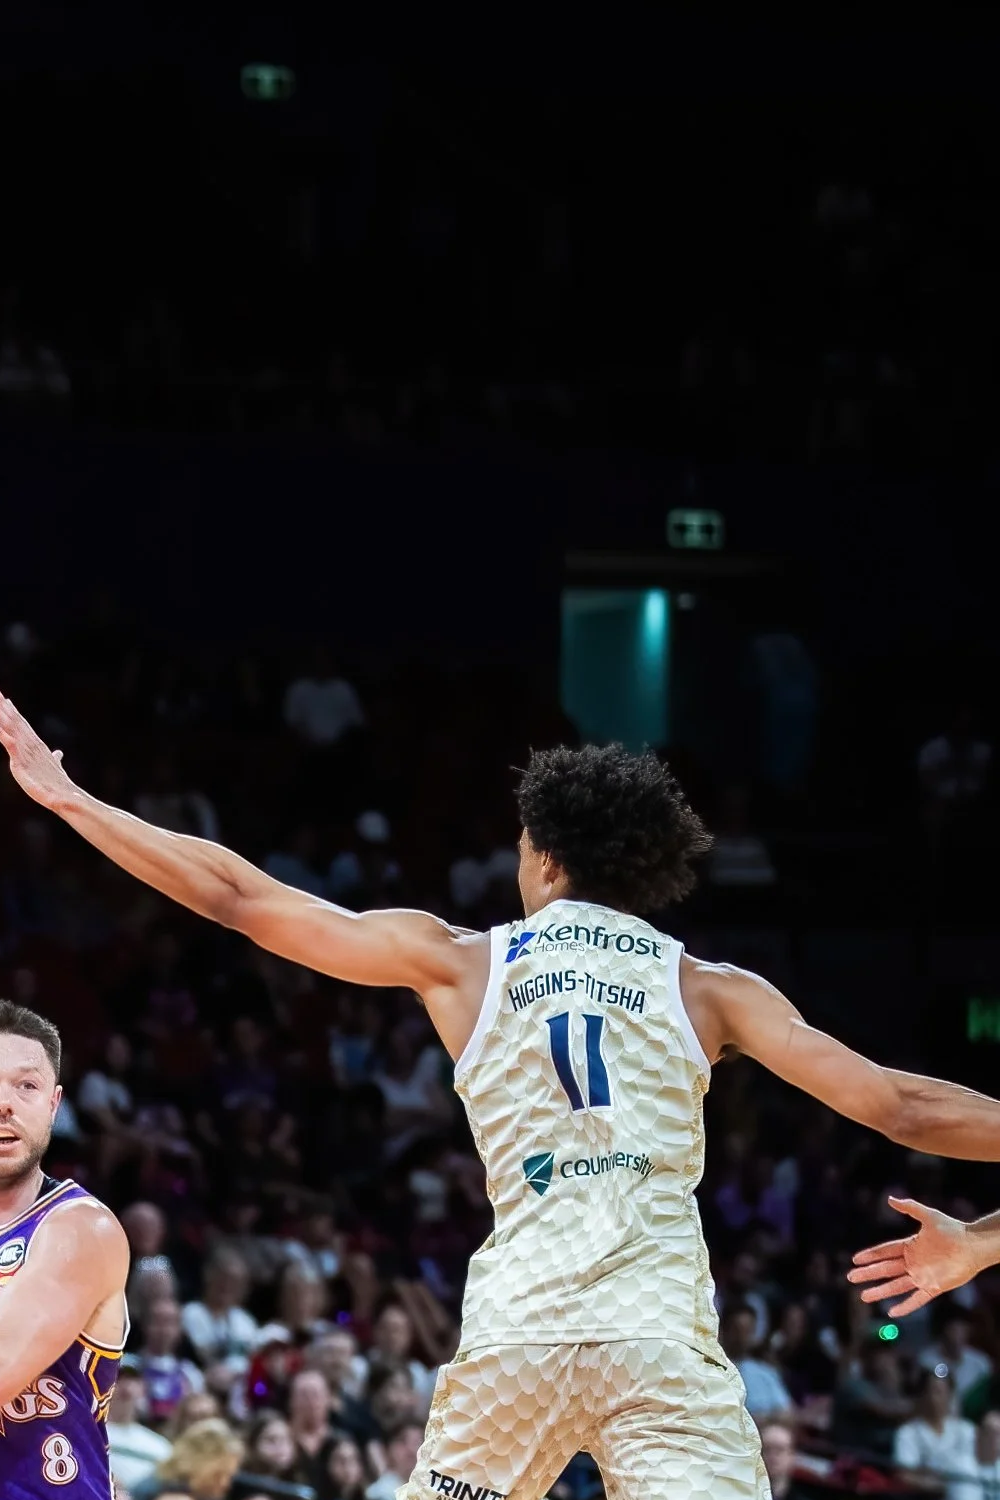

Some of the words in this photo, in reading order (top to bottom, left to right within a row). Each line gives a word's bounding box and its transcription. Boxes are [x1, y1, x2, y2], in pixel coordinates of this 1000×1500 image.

[533, 940, 585, 954] Homes
[536, 923, 662, 960] Kenfrost
[508, 969, 646, 1014] HIGGINS-TITSHA
[544, 1010, 614, 1114] 11
[41, 1432, 79, 1485] 8
